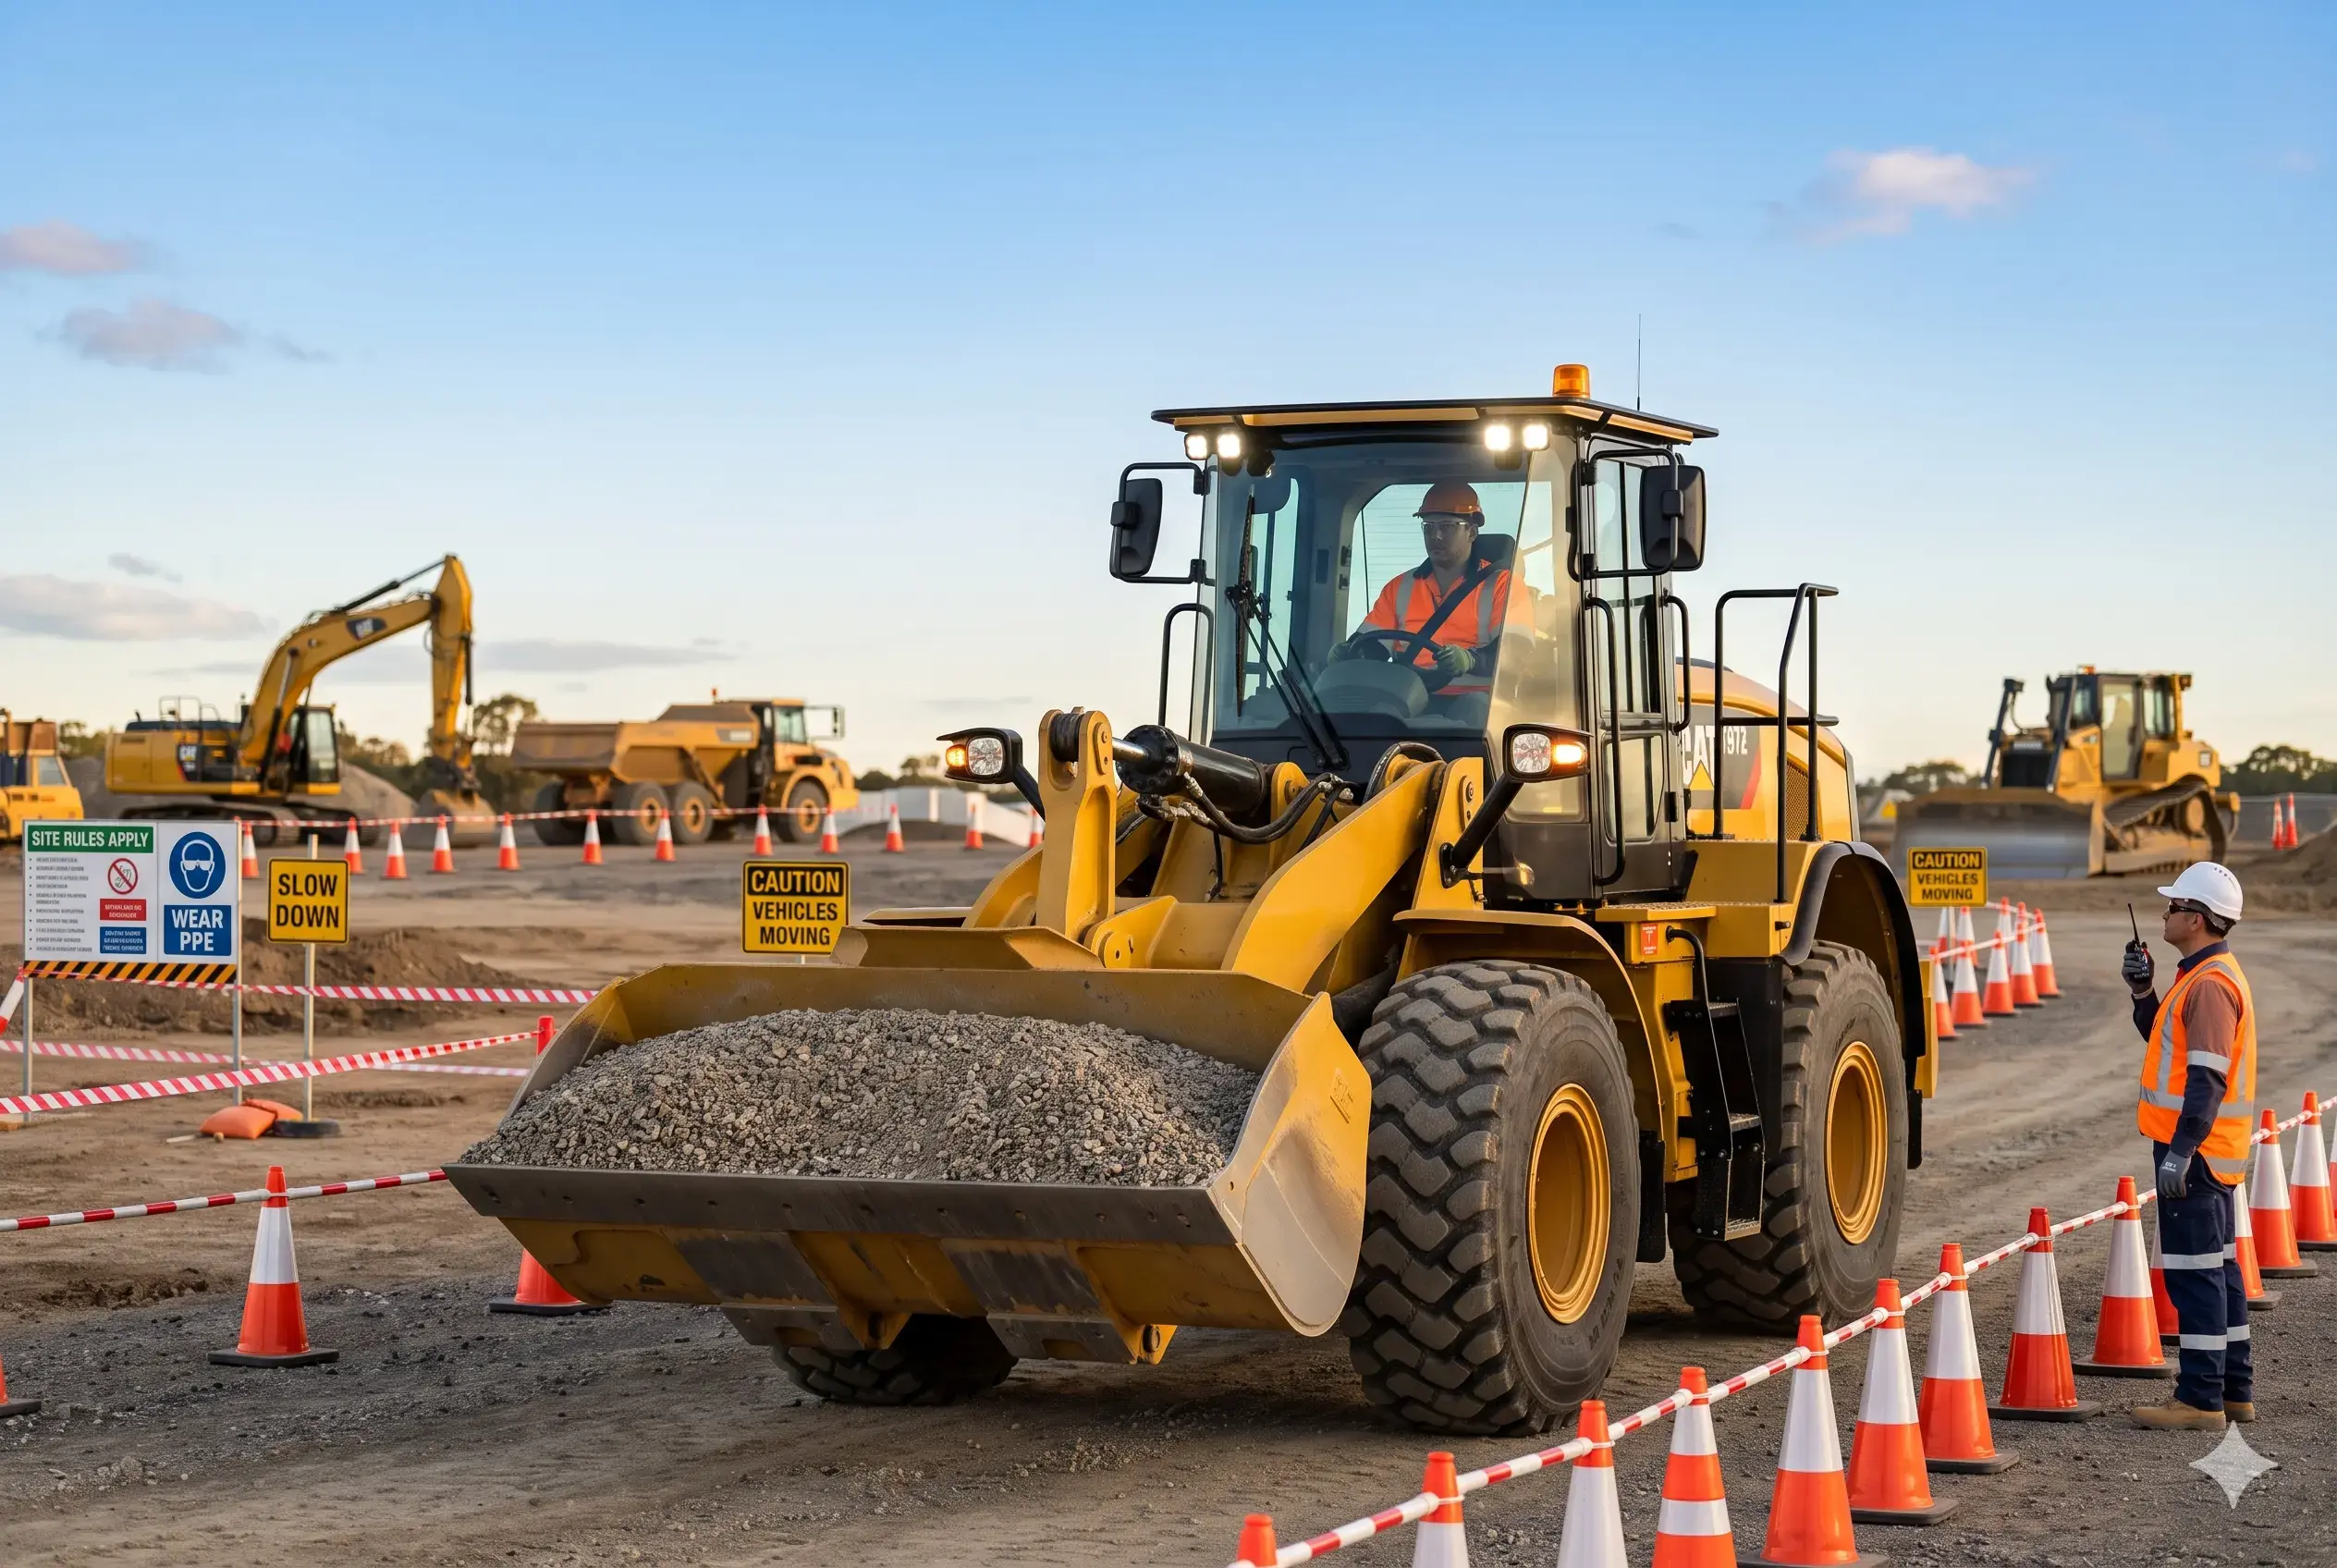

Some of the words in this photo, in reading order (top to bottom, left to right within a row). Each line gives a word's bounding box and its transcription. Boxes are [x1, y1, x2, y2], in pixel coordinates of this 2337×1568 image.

[31, 830, 60, 847] SITE
[64, 831, 104, 847] RULES
[108, 832, 149, 848] APPLY
[1914, 852, 1980, 868] CAUTION
[277, 872, 338, 898] SLOW
[751, 869, 840, 894] CAUTION
[1916, 872, 1979, 886] VEHICLES
[1921, 888, 1974, 900] MOVING
[171, 908, 224, 929] WEAR
[275, 903, 339, 929] DOWN
[752, 900, 838, 922] VEHICLES
[179, 931, 214, 952] PPE
[759, 925, 831, 946] MOVING
